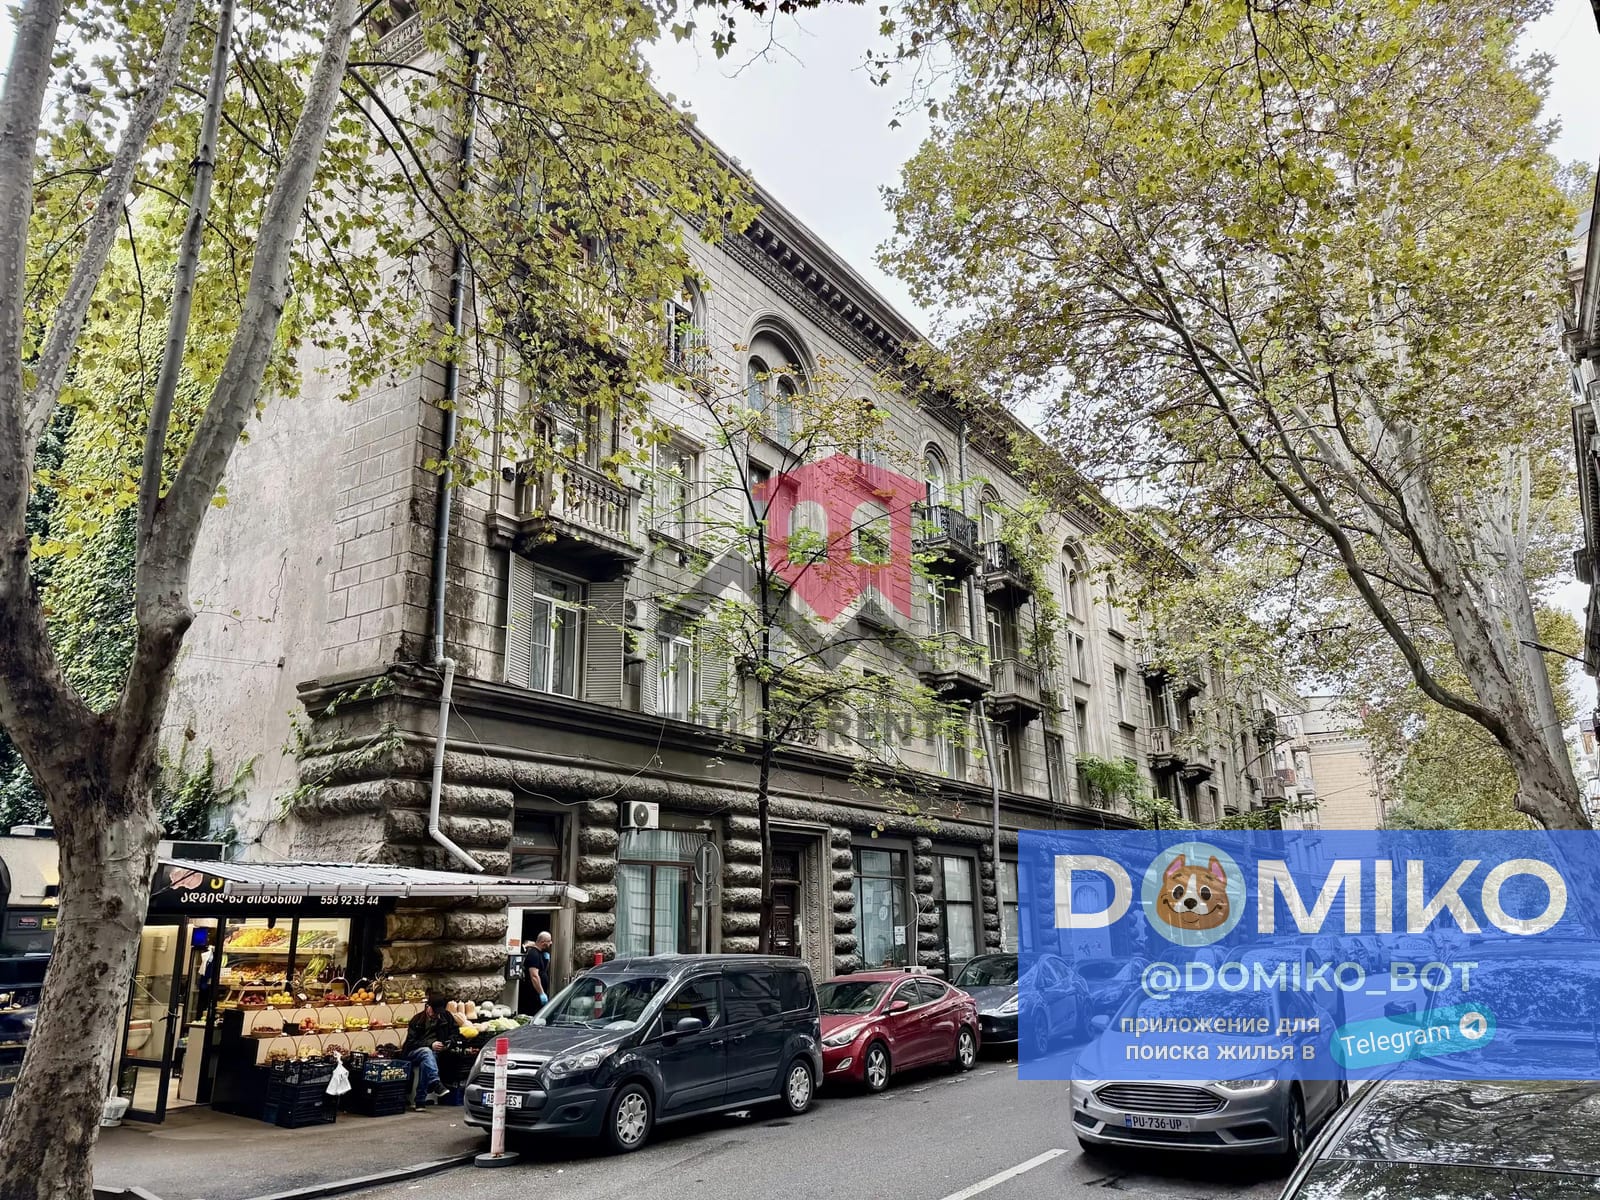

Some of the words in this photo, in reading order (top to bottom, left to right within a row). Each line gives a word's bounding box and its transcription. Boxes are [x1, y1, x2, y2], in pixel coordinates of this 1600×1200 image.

[320, 895, 339, 905] 558
[340, 895, 352, 905] 92
[353, 895, 365, 905] 35
[366, 895, 379, 905] 44
[1132, 1116, 1182, 1129] PU-736-UP
